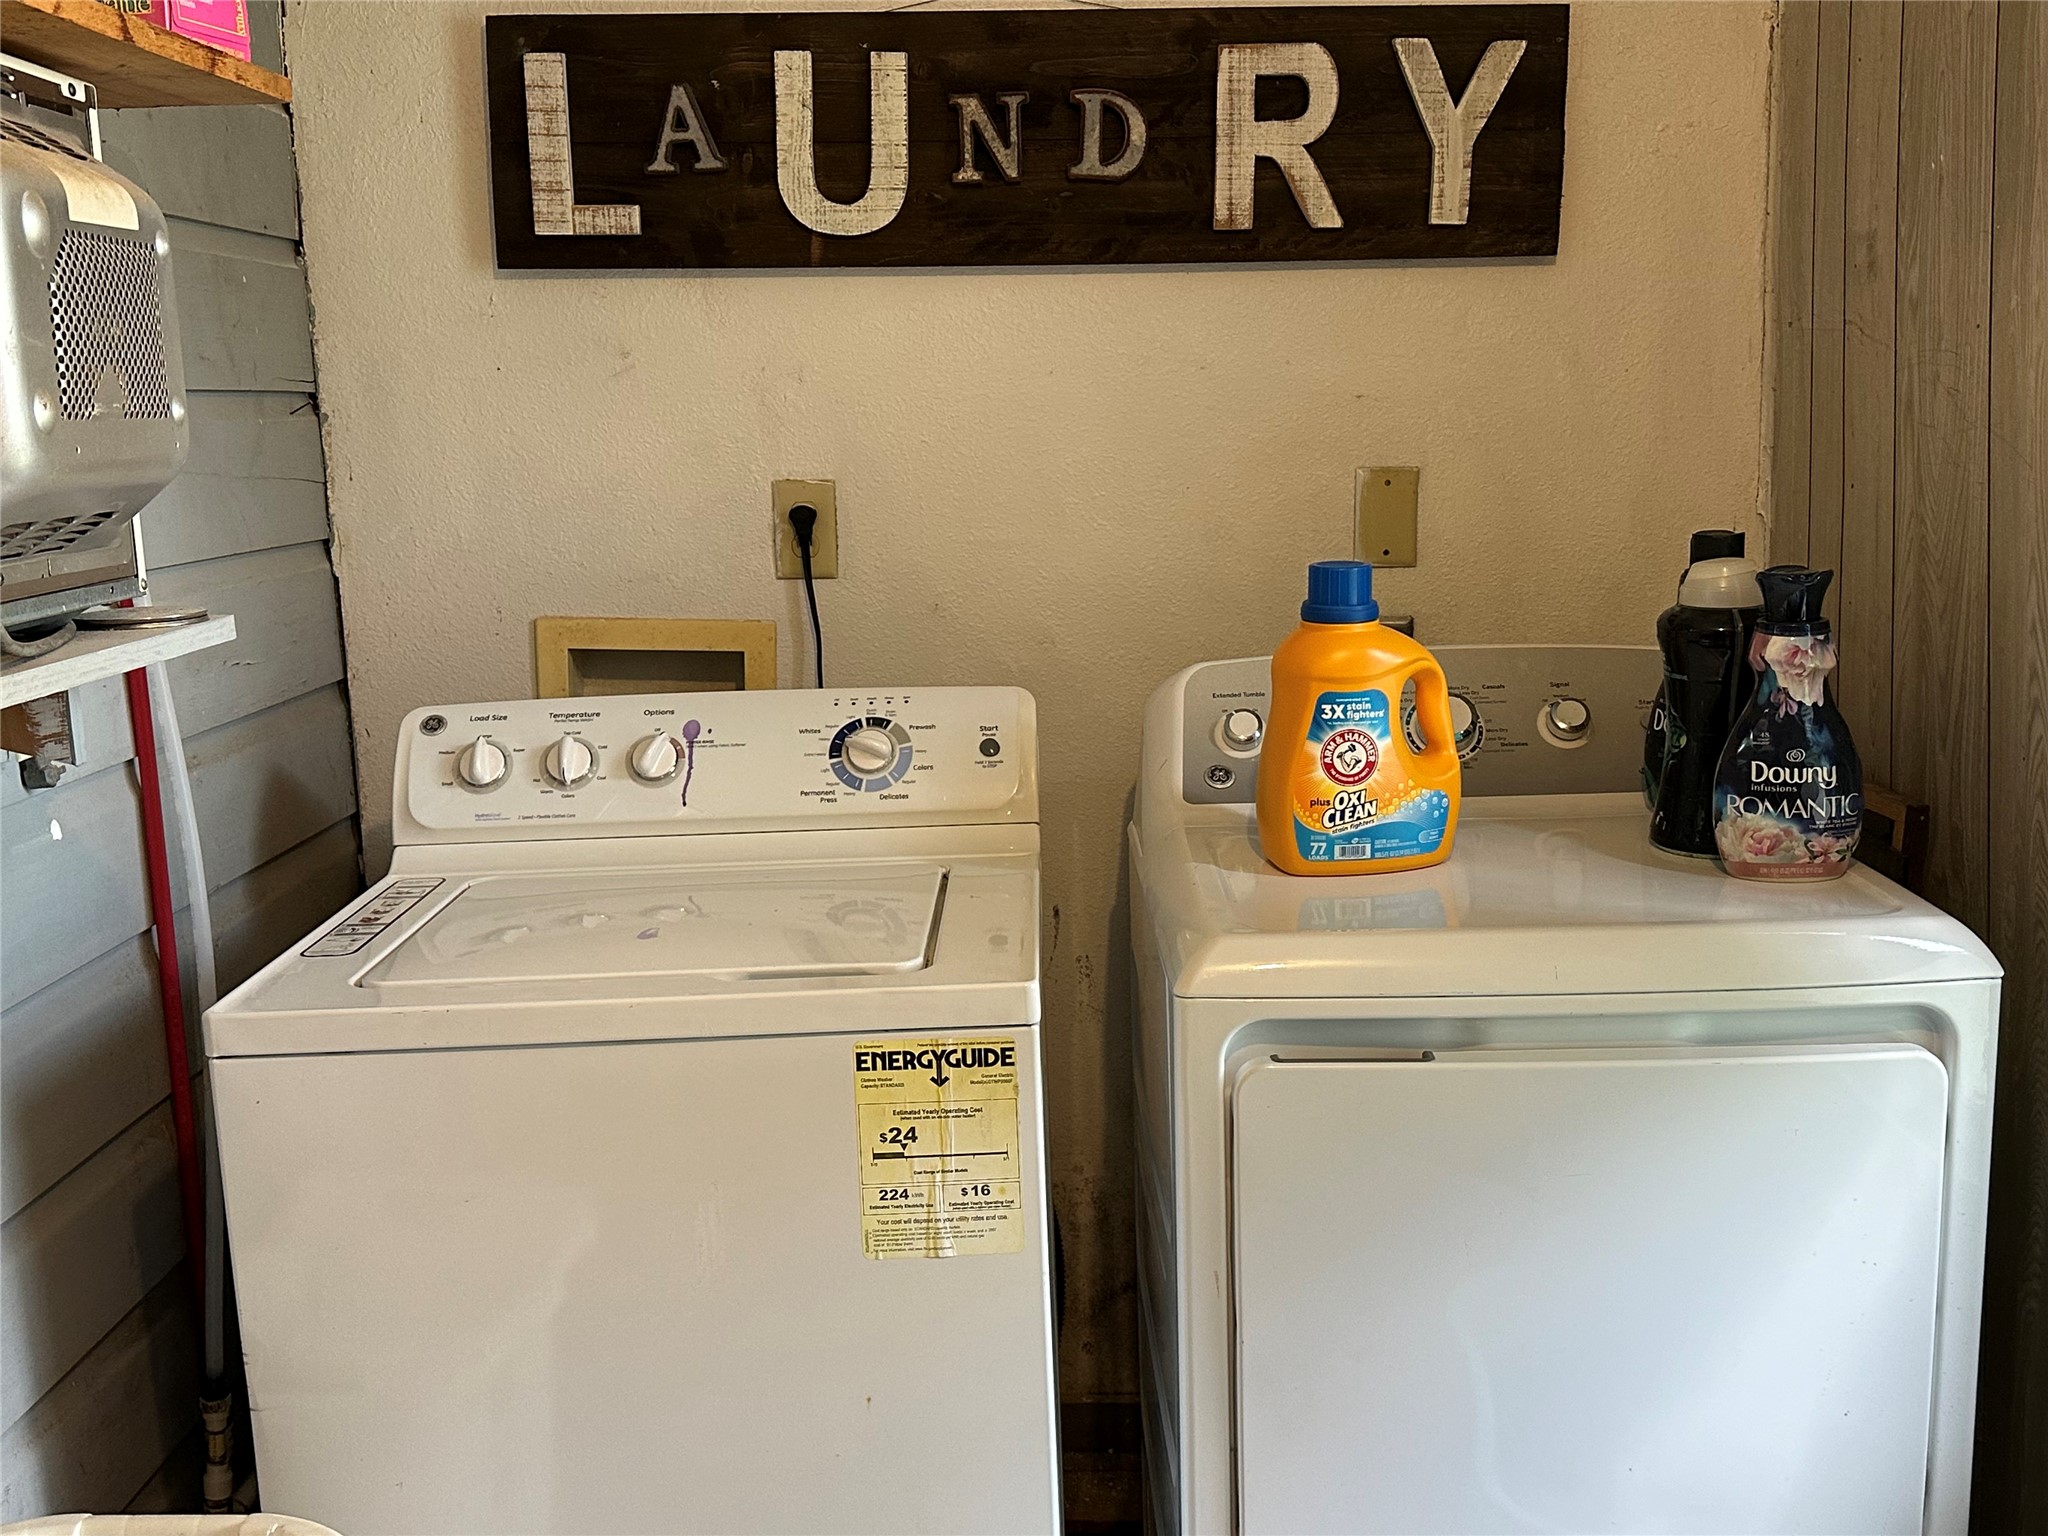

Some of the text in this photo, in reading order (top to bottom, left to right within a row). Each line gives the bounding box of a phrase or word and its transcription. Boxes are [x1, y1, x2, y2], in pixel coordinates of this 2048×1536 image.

[522, 37, 1528, 237] LAUNDRY
[469, 714, 490, 722] Load
[548, 711, 601, 720] Temperature
[643, 709, 675, 717] Options
[1320, 701, 1372, 720] 3X stain
[1323, 732, 1376, 764] ARM & HAMMER
[1751, 760, 1837, 790] Downy
[800, 789, 836, 797] Permanent
[1751, 783, 1798, 793] infusions
[879, 793, 909, 801] Delicates
[1309, 789, 1366, 811] plus OXI
[1726, 792, 1859, 819] ROMANTIC
[1322, 799, 1377, 829] CLEAN
[1331, 819, 1375, 835] stain fighters
[1309, 842, 1327, 856] 77
[855, 1047, 1016, 1072] ENERGYGUIDE
[892, 1108, 921, 1116] Estimated
[921, 1108, 940, 1116] Yearly
[940, 1107, 969, 1115] Operating
[879, 1126, 919, 1144] $24
[878, 1188, 910, 1201] 224
[913, 1217, 933, 1225] depend
[942, 1216, 955, 1224] your
[985, 1213, 997, 1221] and
